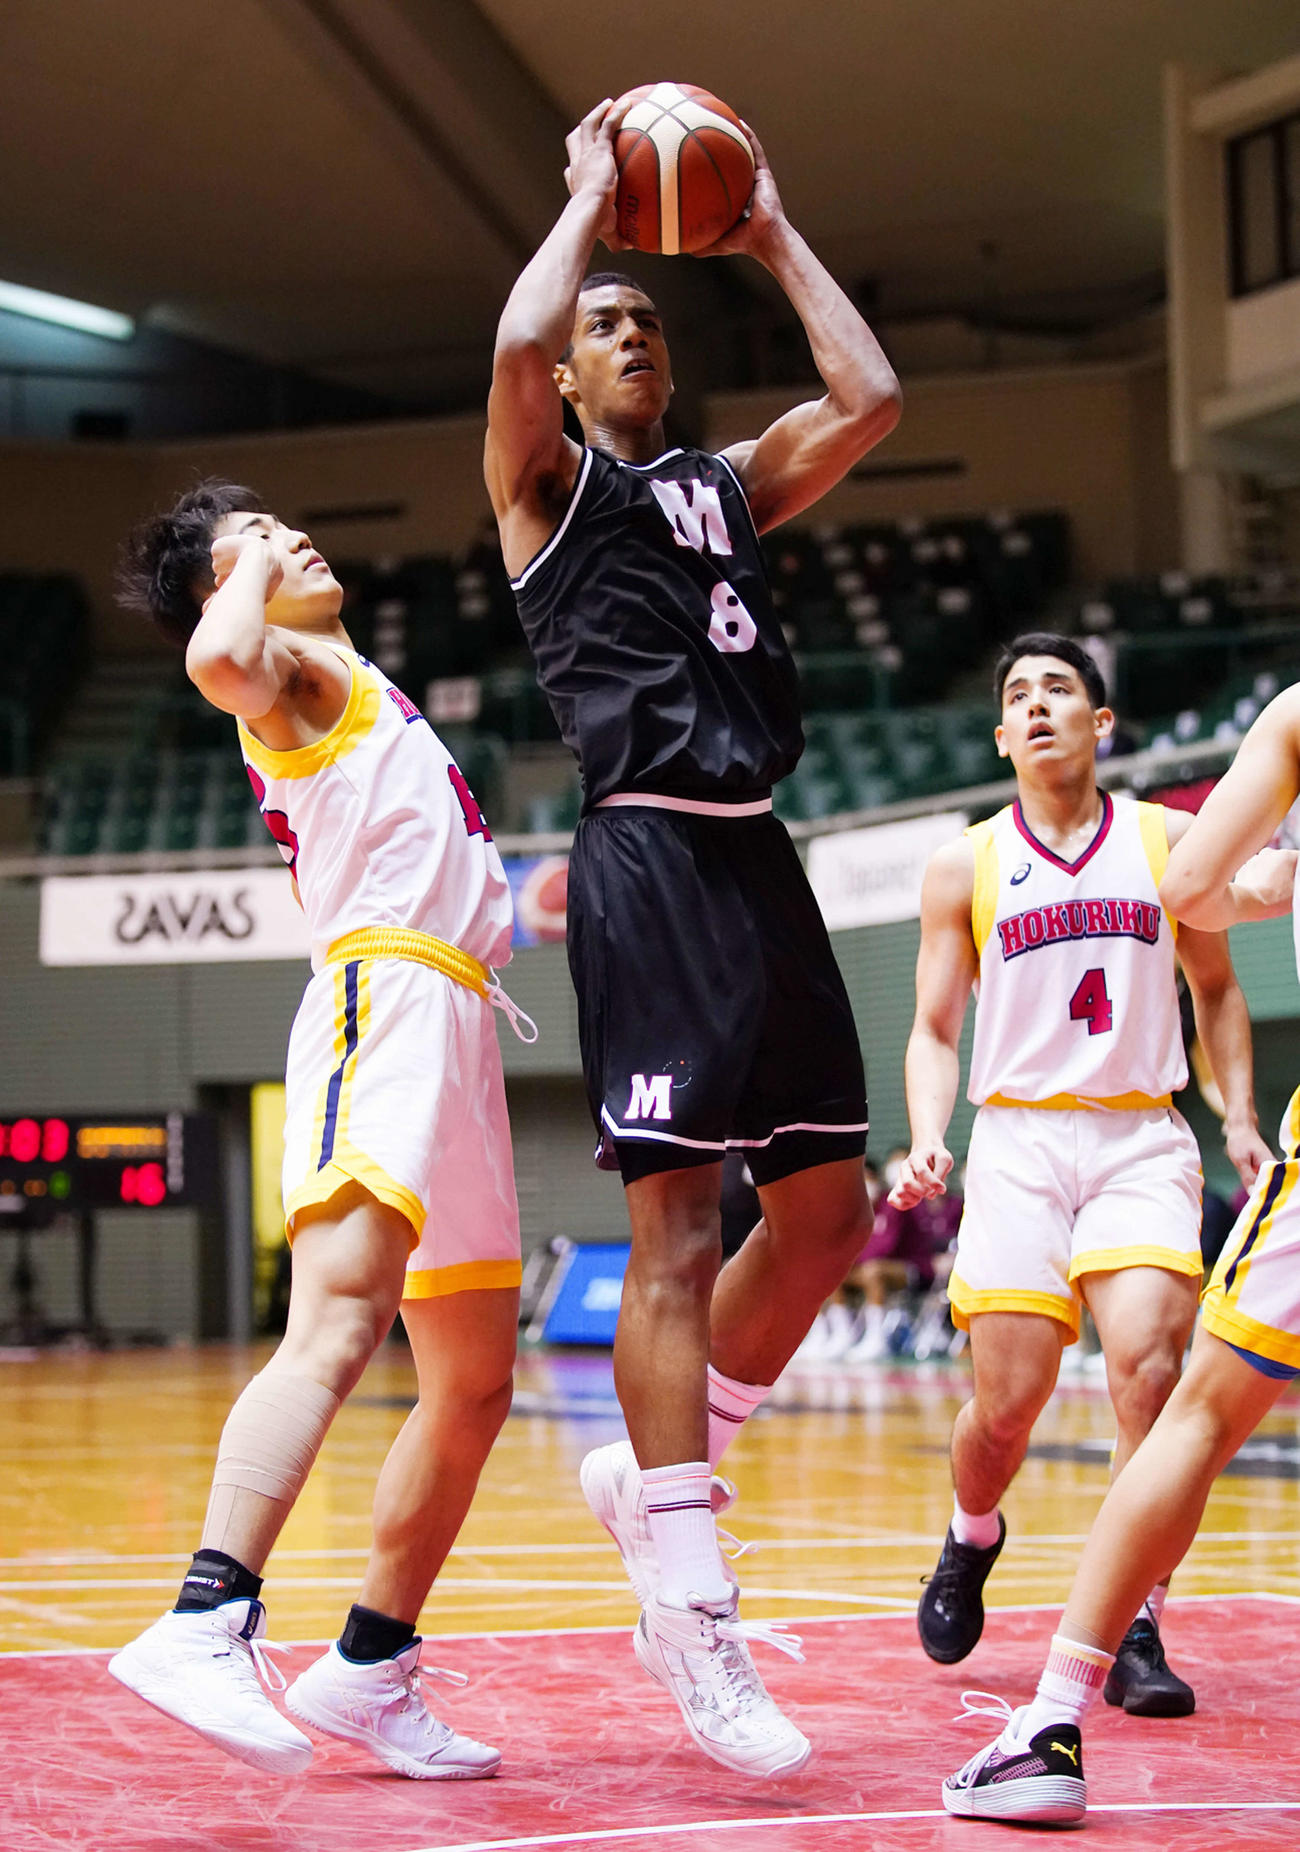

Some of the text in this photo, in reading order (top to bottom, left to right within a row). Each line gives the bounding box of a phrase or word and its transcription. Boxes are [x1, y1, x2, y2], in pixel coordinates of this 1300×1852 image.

[649, 478, 733, 555] M
[707, 580, 757, 652] 8
[116, 889, 254, 943] SAVAS
[997, 898, 1160, 962] HOKURIKU
[1069, 967, 1112, 1036] 4
[623, 1073, 672, 1120] M
